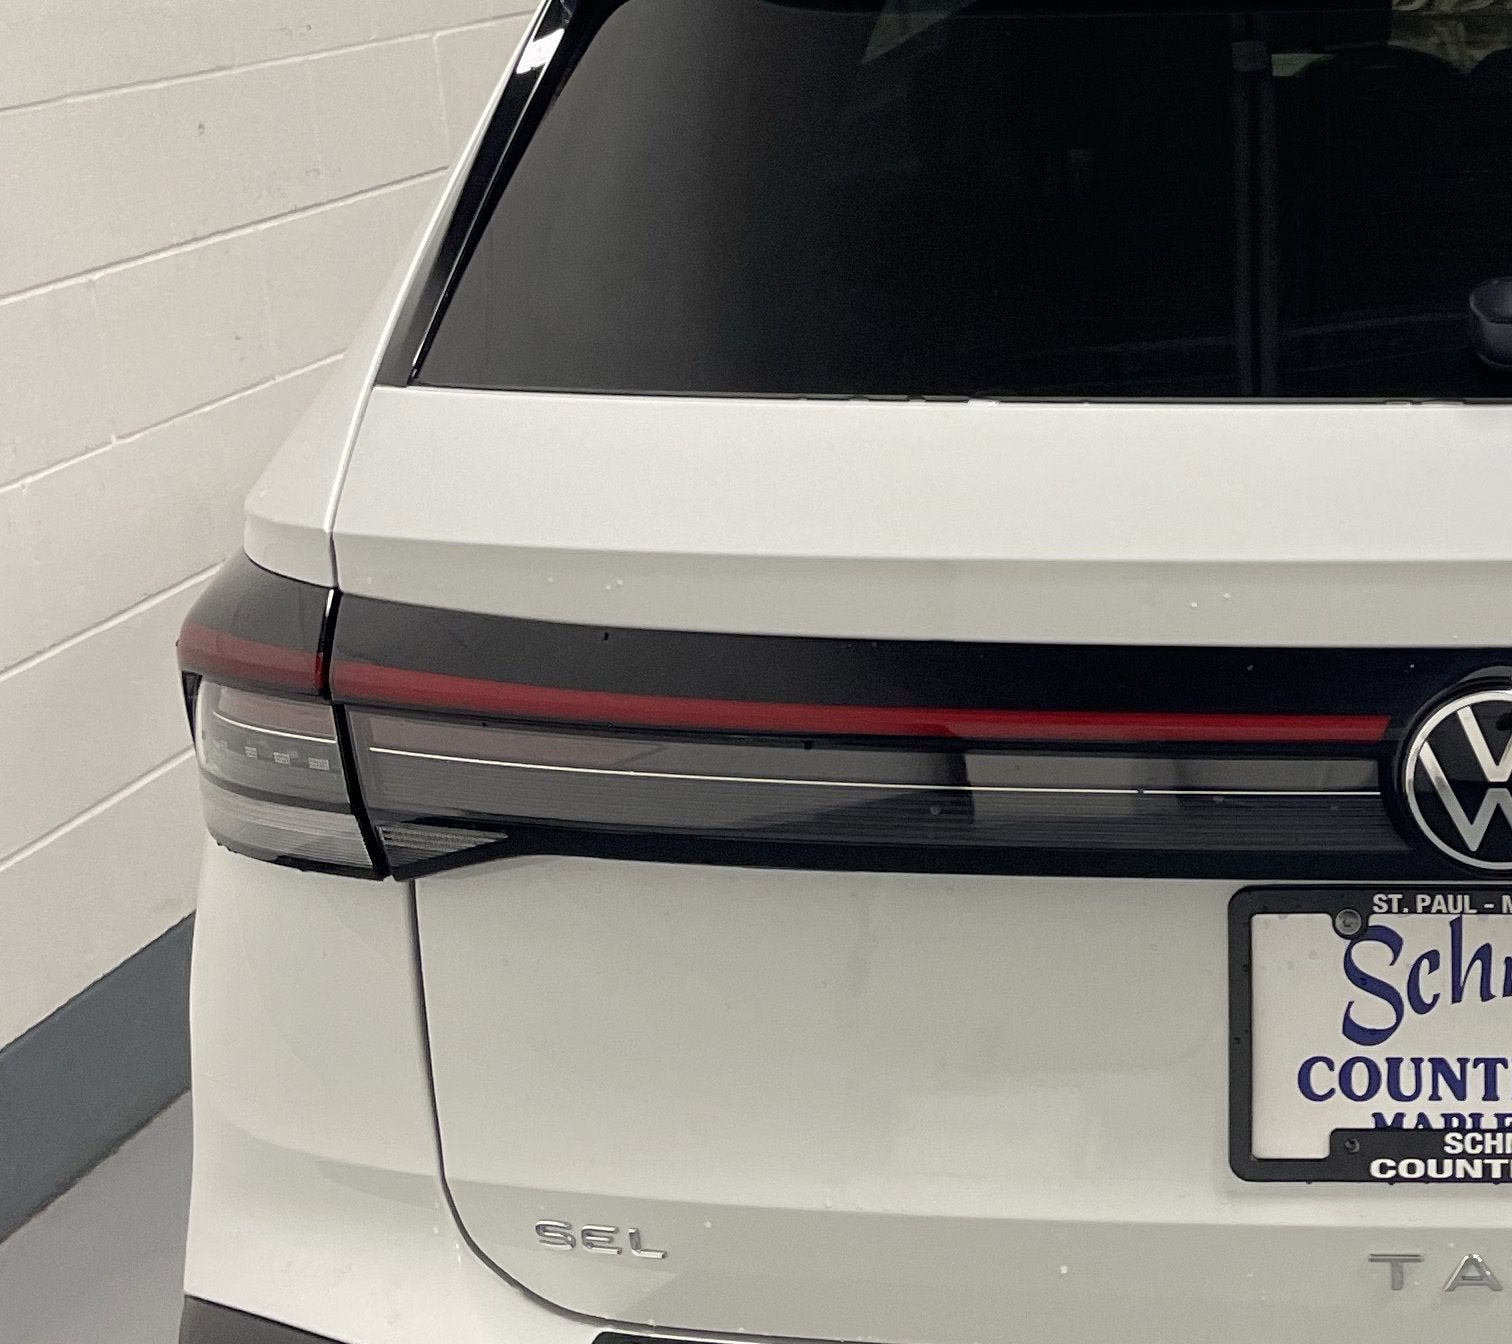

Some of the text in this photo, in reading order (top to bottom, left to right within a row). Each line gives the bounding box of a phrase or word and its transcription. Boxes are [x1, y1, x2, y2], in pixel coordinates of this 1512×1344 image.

[1372, 894, 1409, 914] ST.
[1416, 894, 1477, 914] PAUL
[535, 1219, 668, 1260] SEL
